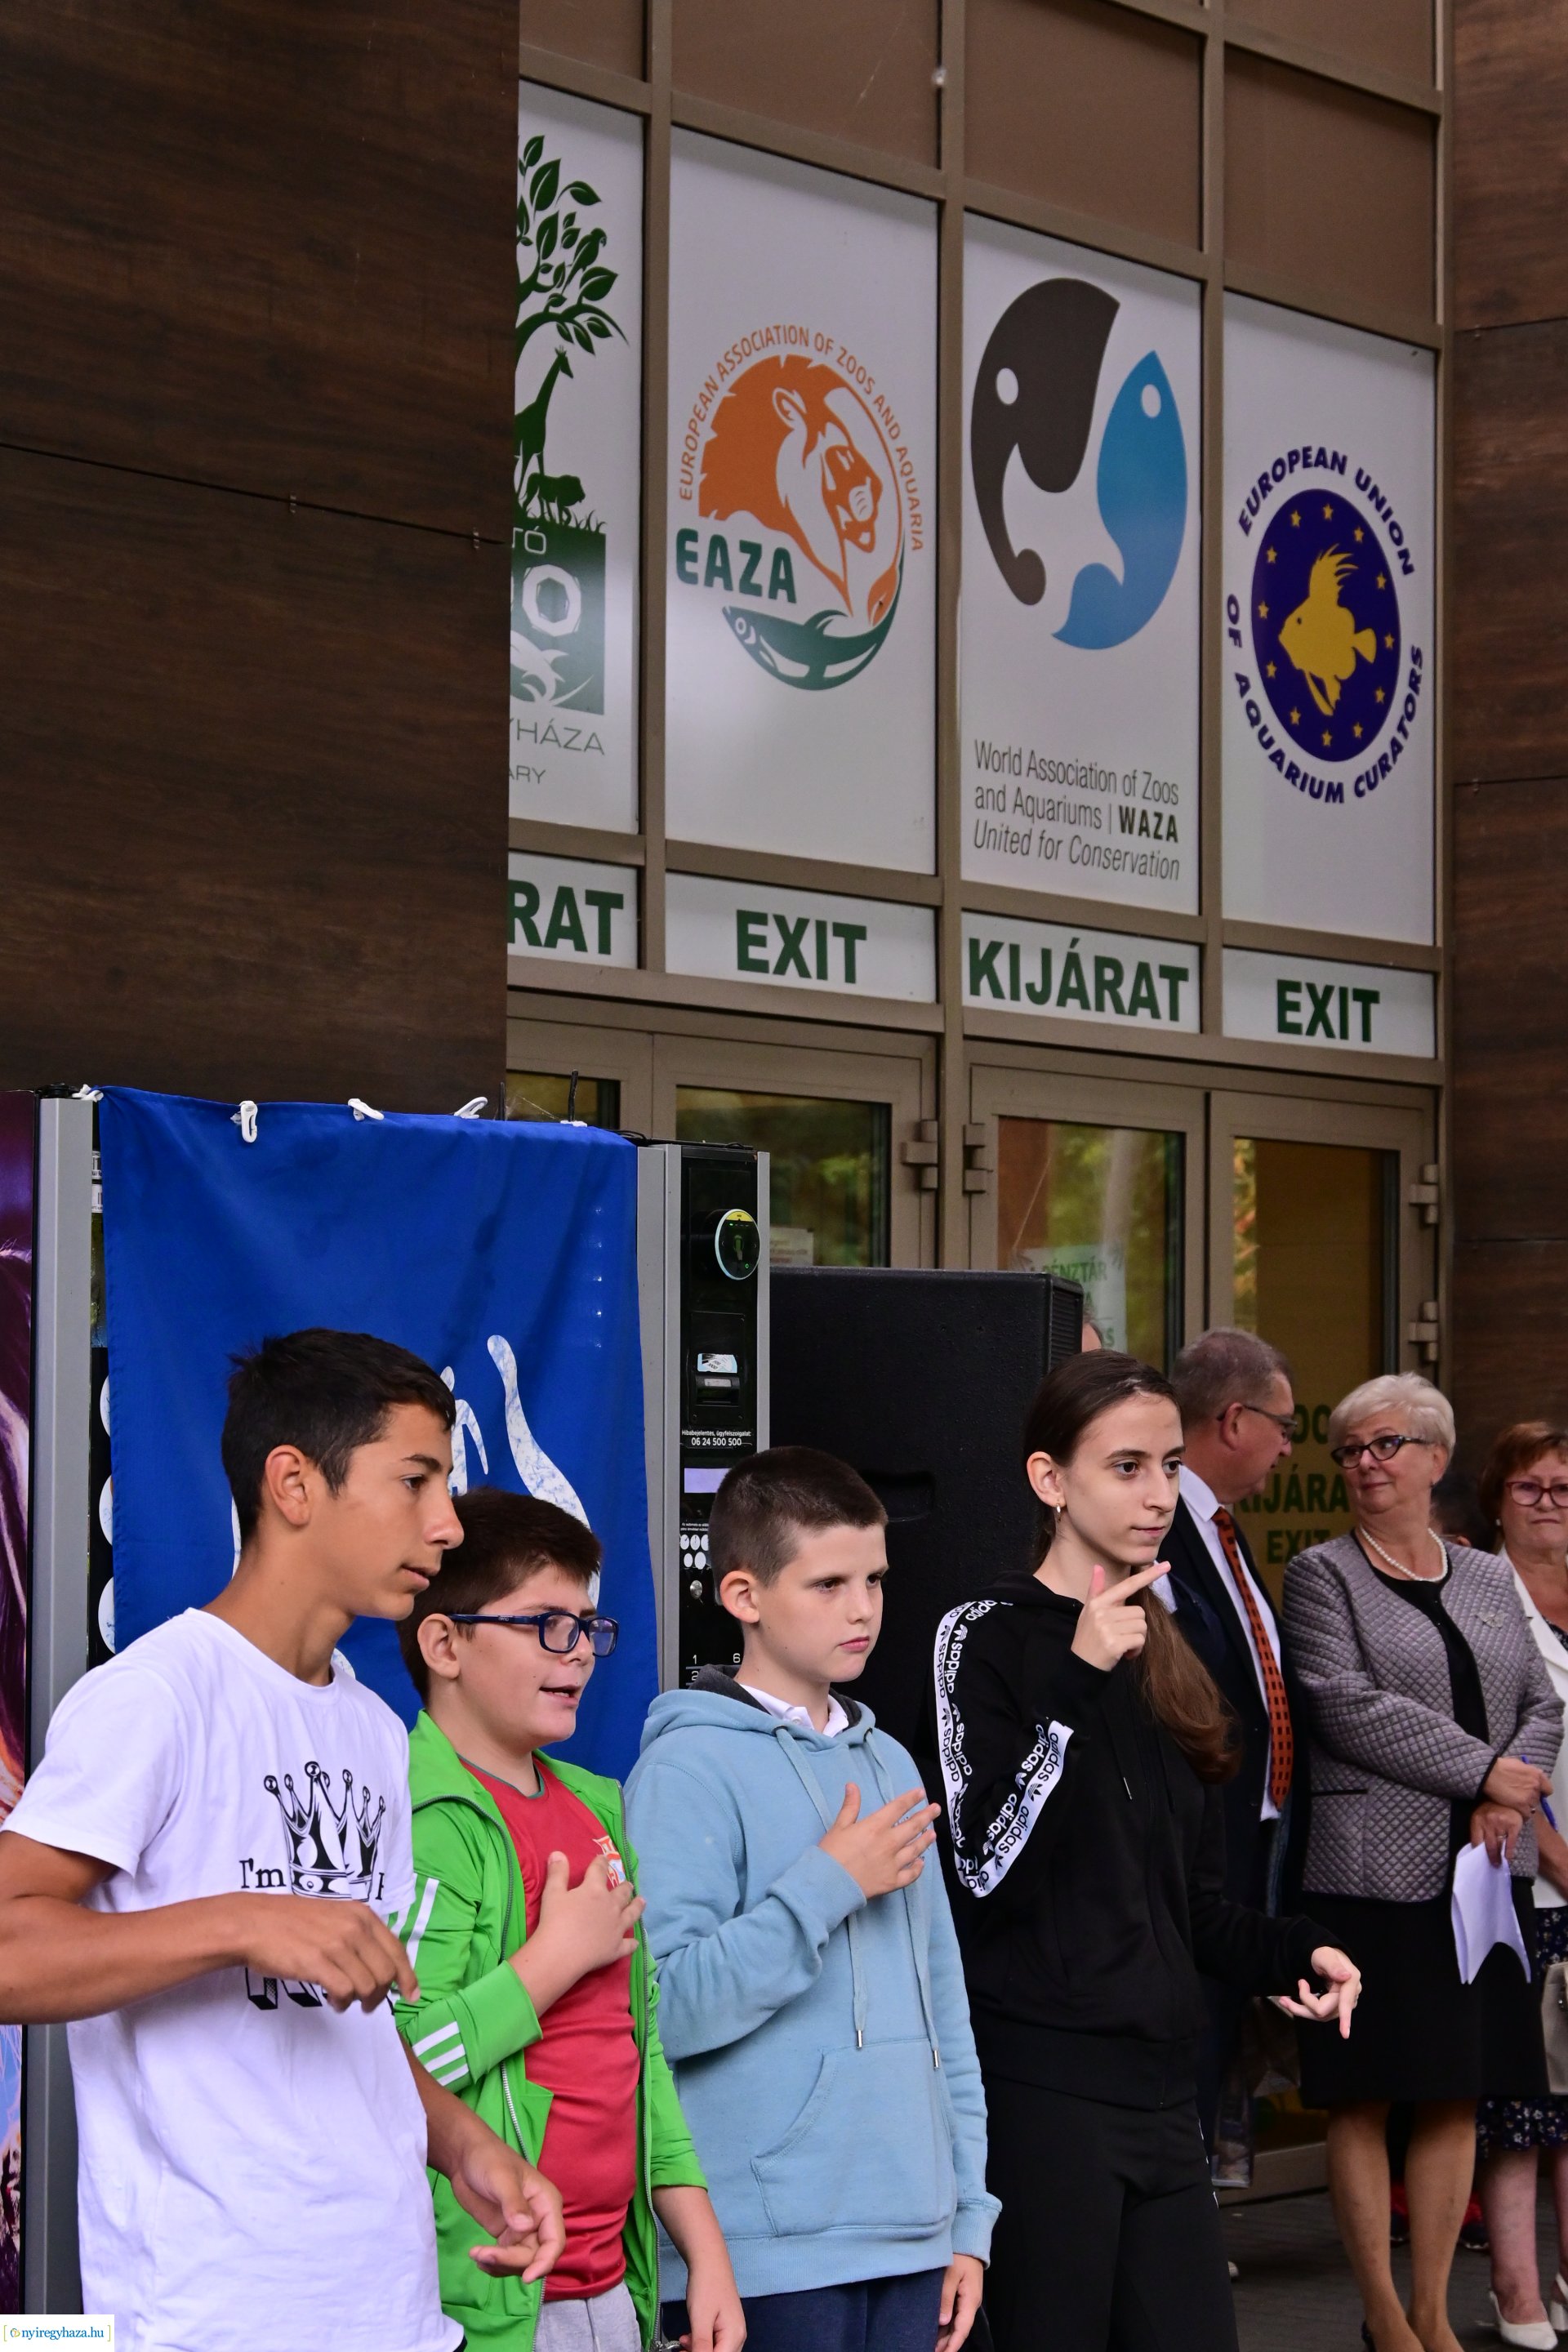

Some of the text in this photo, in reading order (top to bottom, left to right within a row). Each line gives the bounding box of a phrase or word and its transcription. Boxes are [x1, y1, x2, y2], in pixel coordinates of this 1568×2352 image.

[679, 324, 924, 552] EUROPEAN ASSOCIATION OF ZOOS AND AQUARIA
[1238, 445, 1415, 576] EUROPEAN UNION
[675, 527, 797, 604] EAZA
[1227, 593, 1424, 804] OF AQUARIUM CURATORS
[510, 719, 604, 755] HÁZA
[974, 738, 1179, 806] World Association of Zoos
[974, 783, 1179, 844] and Aquariums WAZA
[973, 818, 1180, 881] United for Conservation
[736, 908, 868, 984] EXIT
[968, 937, 1189, 1023] KIJÁRAT
[1276, 978, 1381, 1043] EXIT
[691, 1437, 742, 1446] 06 24 500 500
[691, 1670, 699, 1682] 2
[692, 1654, 697, 1665] 1
[733, 1652, 742, 1664] 6
[937, 1643, 947, 1699] adidas
[944, 1642, 964, 1694] adidas
[942, 1727, 960, 1782] adidas
[951, 1722, 973, 1775] adidas
[1022, 1724, 1050, 1772] adidas
[1037, 1732, 1061, 1782] adidas
[986, 1793, 1018, 1841] adidas
[998, 1806, 1030, 1854] adidas
[238, 1857, 287, 1890] I'm
